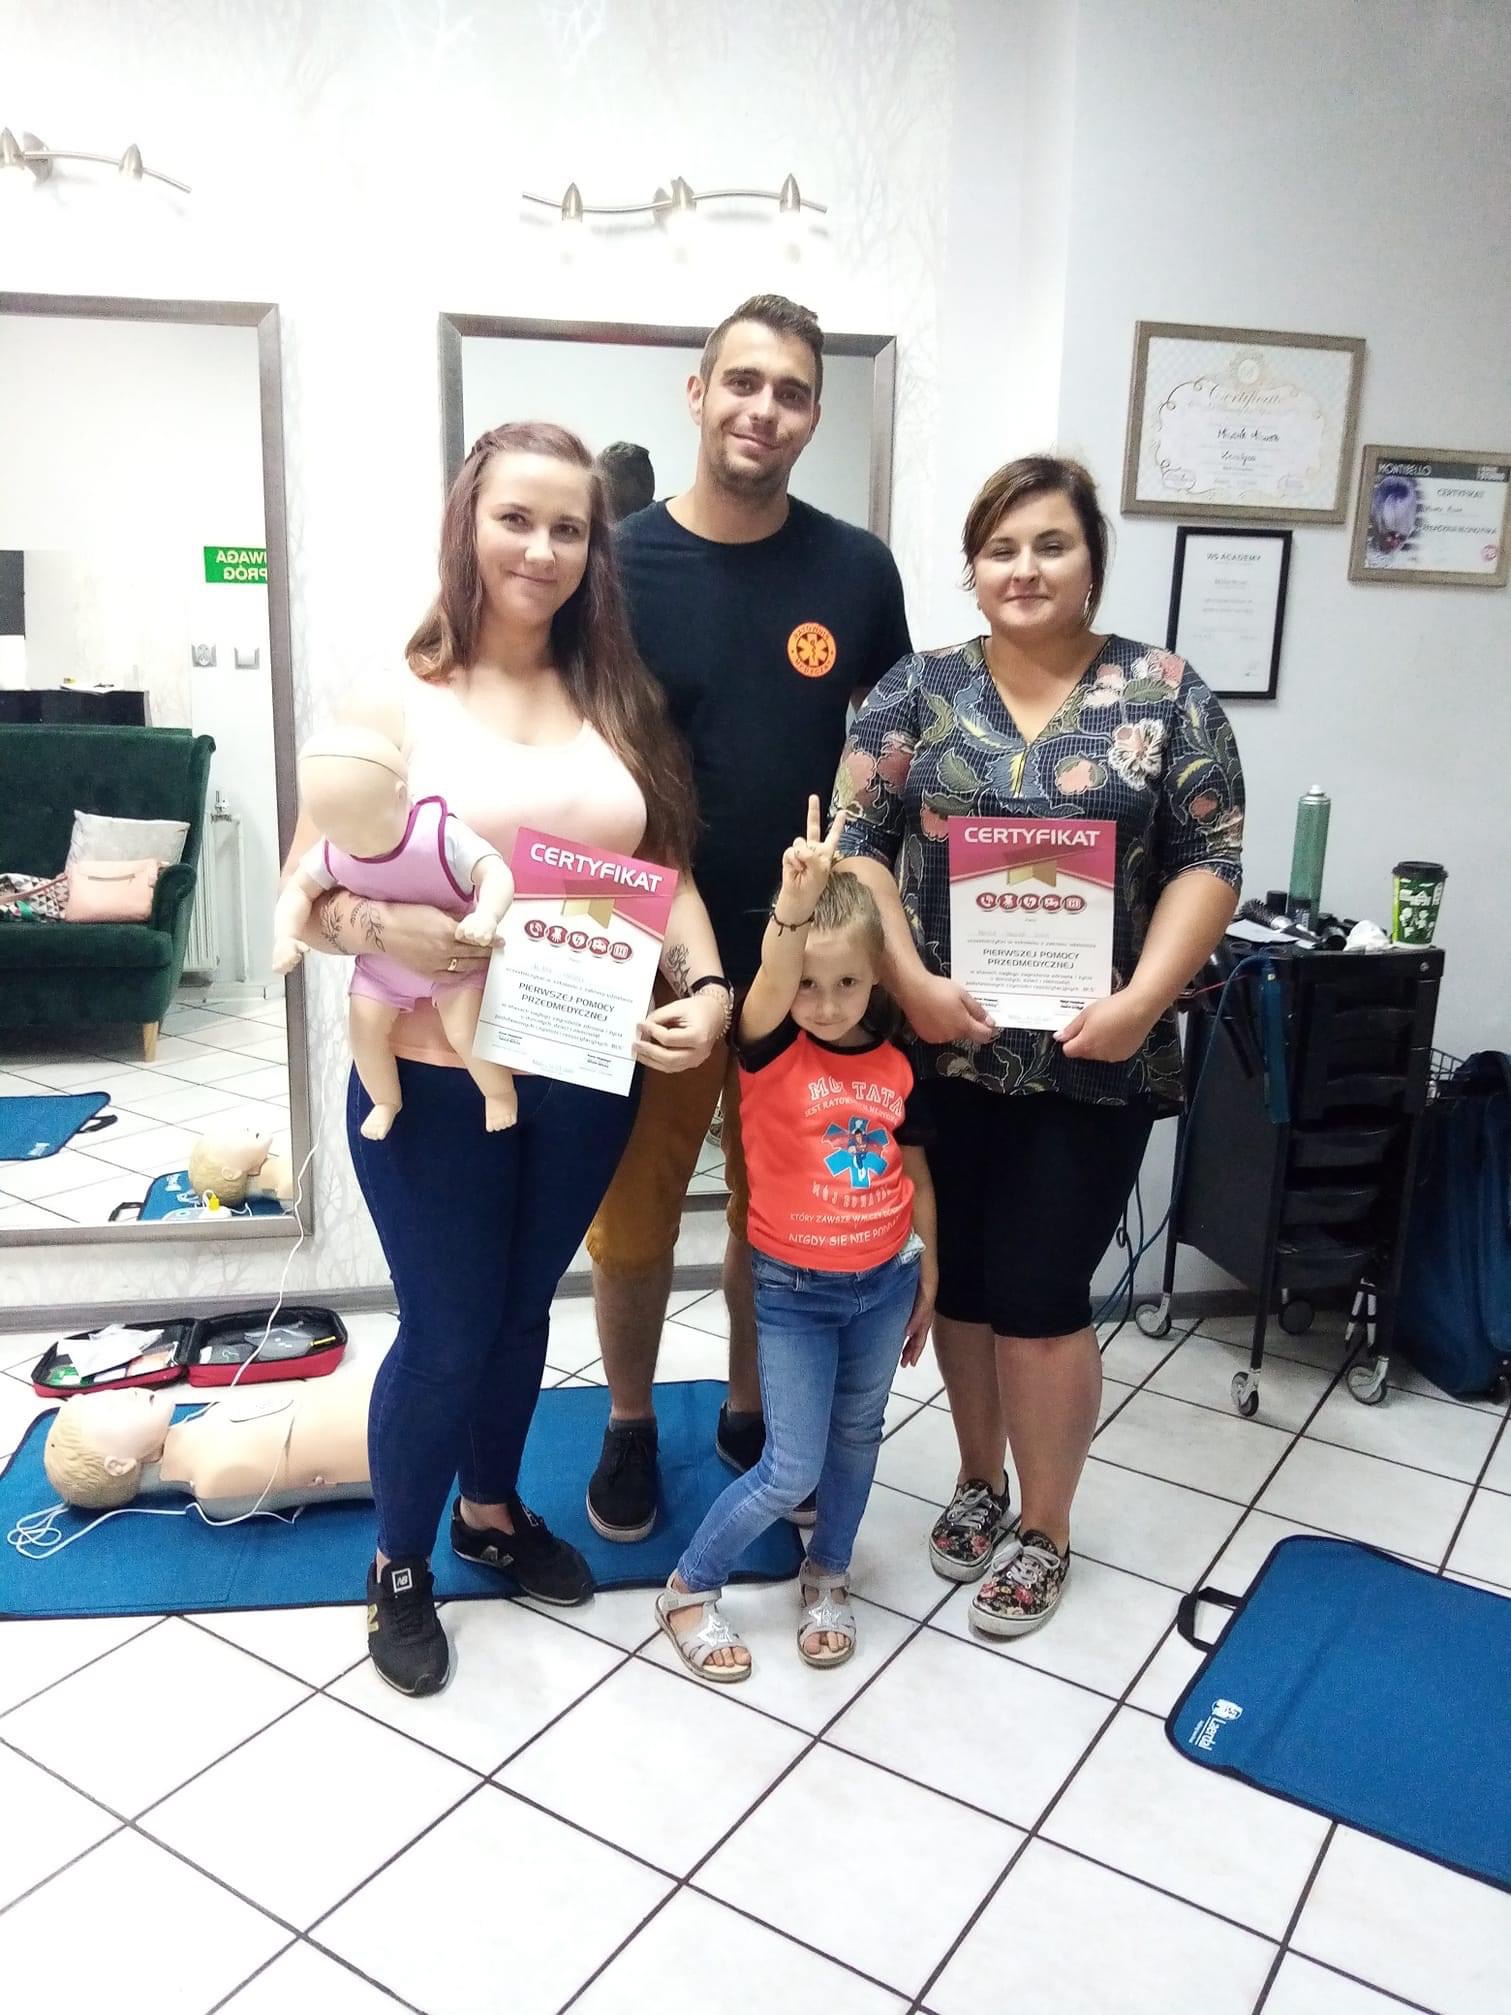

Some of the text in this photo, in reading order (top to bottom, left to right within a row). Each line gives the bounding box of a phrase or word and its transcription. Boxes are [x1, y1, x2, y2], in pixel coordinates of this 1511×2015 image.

[964, 826, 1100, 847] CERTYFIKAT
[529, 842, 663, 893] CERTYFIKAT
[983, 948, 1080, 960] PIERWSZEJ POMOCY
[987, 958, 1075, 969] PRZEDMEDYCZNEJ
[518, 982, 574, 1003] PIERWSZEJ
[575, 997, 615, 1013] POMOCY
[521, 994, 608, 1022] PRZEDMEDYCZNEJ
[851, 1081, 905, 1116] TATA
[790, 1212, 815, 1222] KTÓRY
[789, 1232, 826, 1246] NIGDY
[850, 1230, 871, 1244] NIE
[1198, 1718, 1227, 1751] Laerdal
